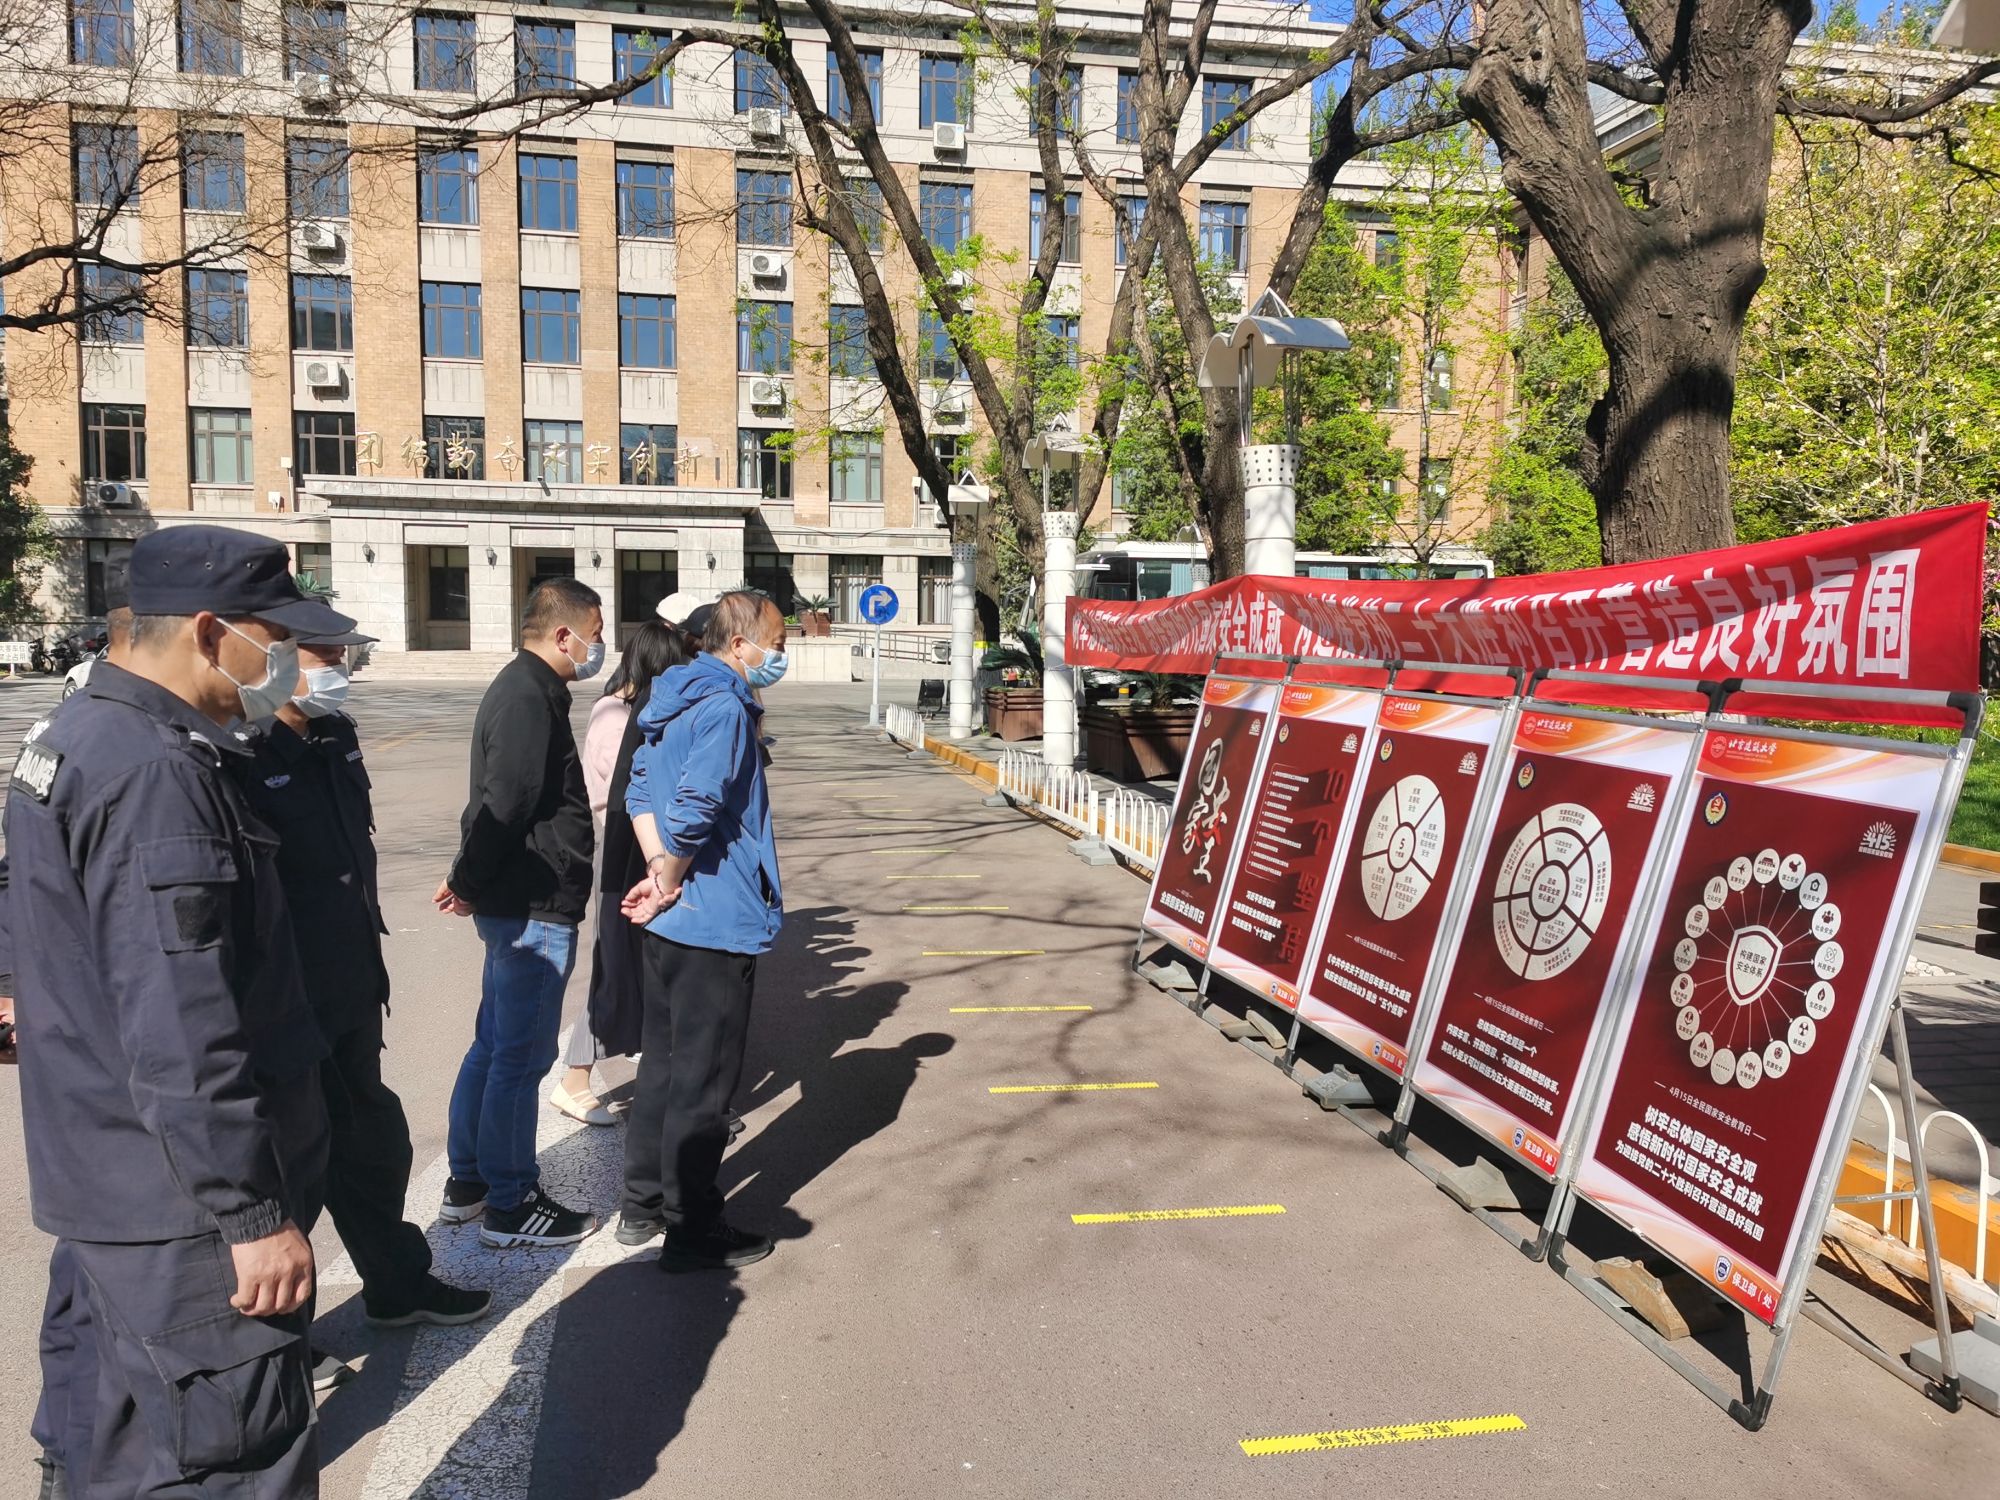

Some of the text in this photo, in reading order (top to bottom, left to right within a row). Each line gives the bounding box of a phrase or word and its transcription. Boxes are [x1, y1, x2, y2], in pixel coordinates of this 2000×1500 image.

[1398, 837, 1405, 849] 5
[1735, 960, 1764, 979] 安全体系
[1738, 949, 1767, 966] 构建国家
[1475, 1017, 1538, 1058] 总体国家安全观是一个
[1667, 1085, 1753, 1136] 4月15日全民国家安全教育日
[1642, 1103, 1760, 1185] 树牢总体国家安全观
[1624, 1119, 1766, 1218] 感悟新时代国家安全成就
[1612, 1138, 1767, 1242] 为迎接党的二十大胜利召开营造良好氛围
[1314, 1424, 1454, 1446] 请在一米线外等候
